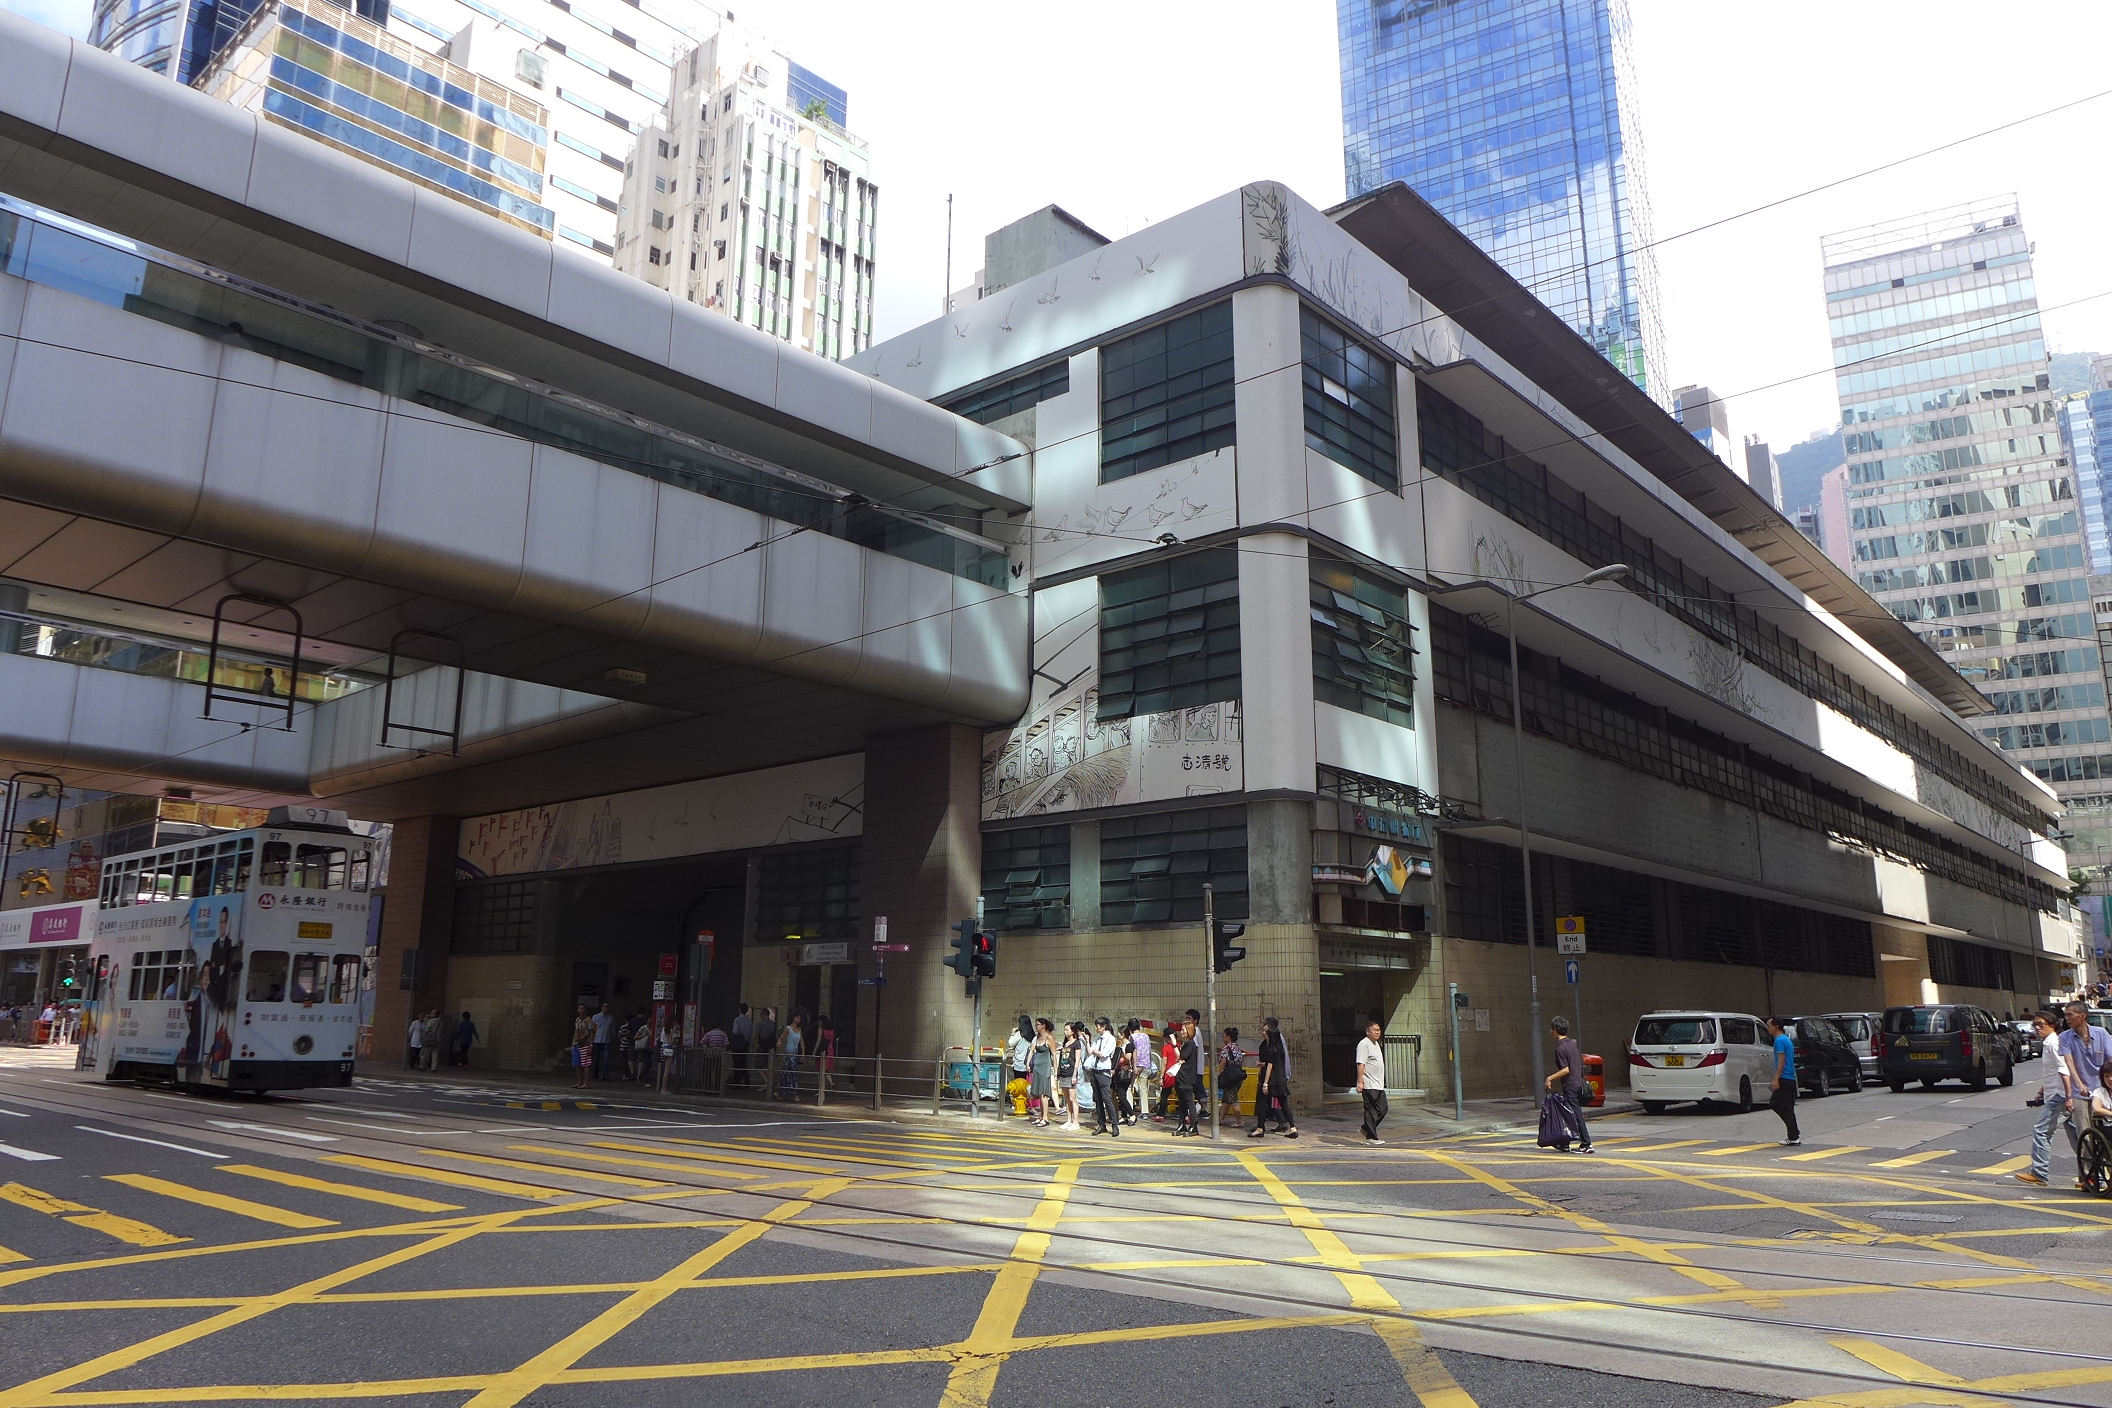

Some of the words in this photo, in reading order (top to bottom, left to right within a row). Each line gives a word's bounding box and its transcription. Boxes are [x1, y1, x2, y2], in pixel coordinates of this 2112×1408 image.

[306, 808, 329, 822] 97
[269, 832, 282, 840] 97
[363, 841, 372, 850] 97
[279, 895, 327, 907] 永隆銀行
[1563, 944, 1581, 952] 終止
[341, 1063, 352, 1072] 97
